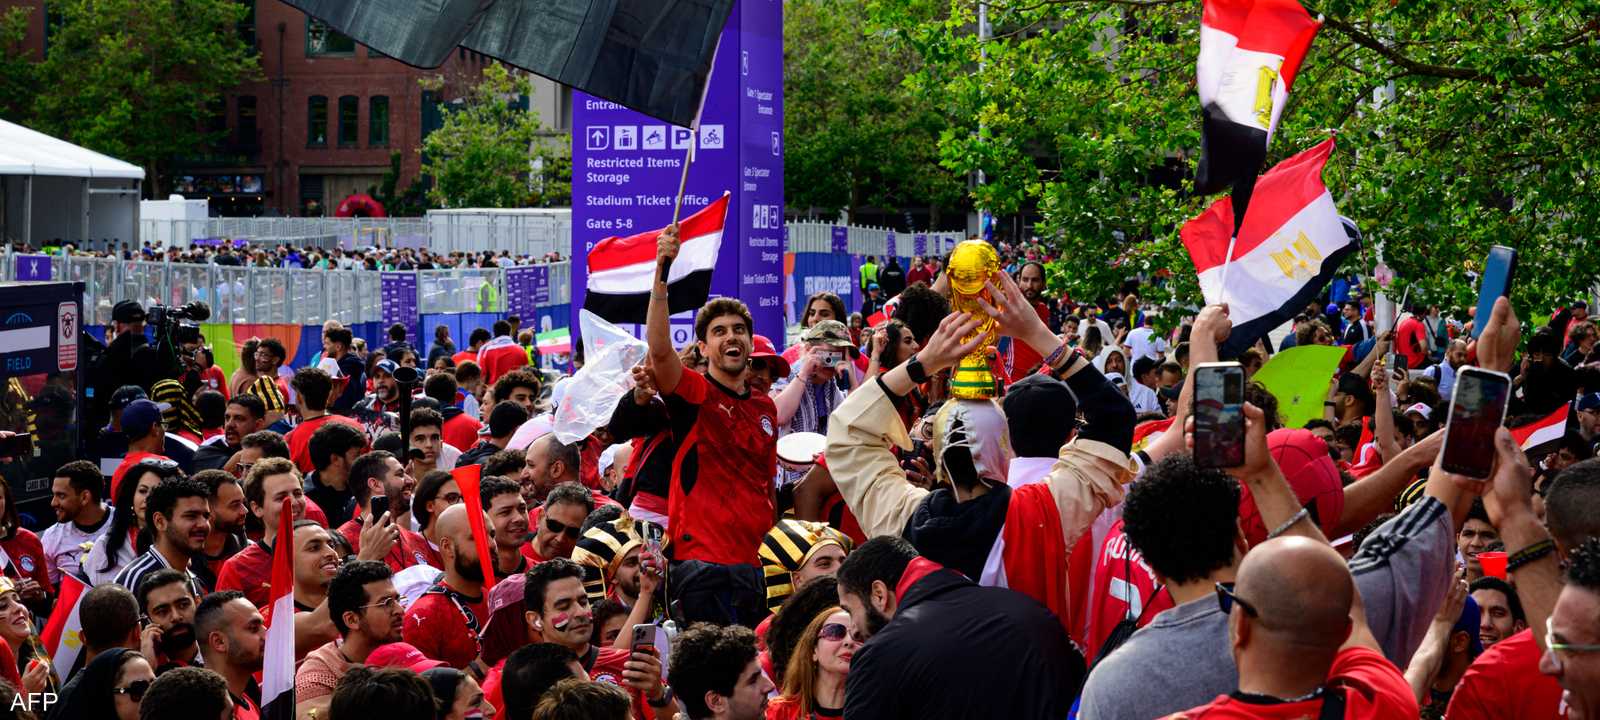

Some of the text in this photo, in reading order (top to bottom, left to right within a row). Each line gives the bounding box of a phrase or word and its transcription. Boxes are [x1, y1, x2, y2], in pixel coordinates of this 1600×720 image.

[586, 157, 680, 168] Restricted Items
[586, 172, 630, 185] Storage
[586, 195, 632, 206] Stadium
[636, 195, 671, 206] Ticket
[586, 219, 633, 229] Gate 5-8
[8, 357, 31, 370] FIELD
